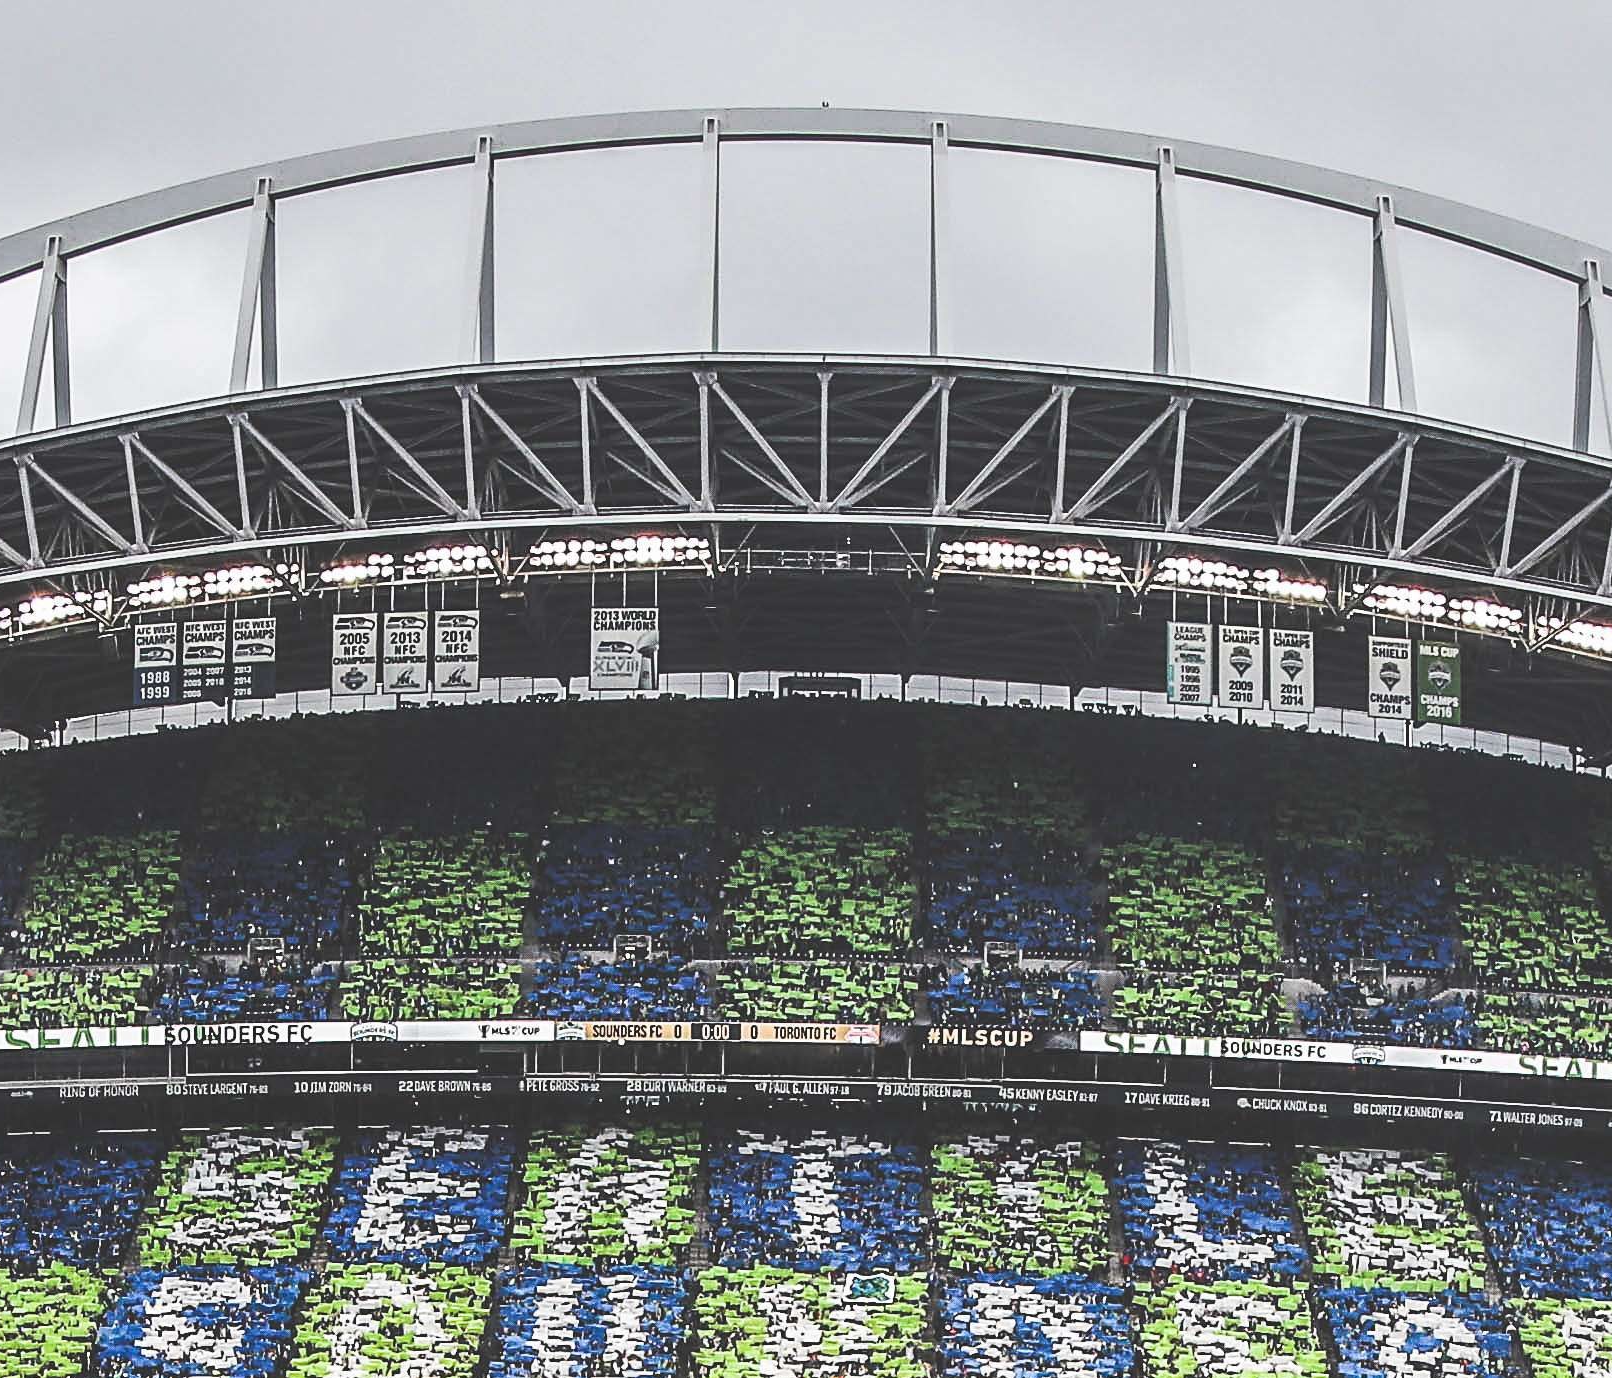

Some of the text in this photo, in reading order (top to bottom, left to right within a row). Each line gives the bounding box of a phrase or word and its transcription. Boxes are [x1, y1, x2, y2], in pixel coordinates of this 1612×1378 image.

[594, 611, 656, 620] 2013 WORLD
[154, 625, 175, 634] WEST
[203, 623, 224, 631] WEST
[253, 620, 274, 629] WEST
[594, 621, 656, 631] CHAMPIONS
[136, 635, 175, 646] CHAMPS
[185, 632, 224, 642] CHAMPS
[235, 629, 274, 640] CHAMPS
[340, 633, 369, 645] 2005
[390, 632, 420, 644] 2013
[442, 630, 472, 643] 2014
[1223, 635, 1259, 645] CHAMPS
[344, 645, 365, 655] NFC
[395, 645, 416, 655] NFC
[446, 643, 468, 653] NFC
[1274, 639, 1310, 649] CHAMPS
[1372, 647, 1408, 659] SHIELD
[1441, 647, 1459, 658] CUP
[593, 661, 638, 672] XLVIII
[140, 671, 170, 684] 1988
[1229, 681, 1253, 691] 2009
[1281, 684, 1303, 695] 2011
[140, 686, 170, 699] 1999
[1229, 692, 1253, 702] 2010
[1280, 695, 1303, 705] 2014
[1370, 693, 1411, 705] CHAMPS
[1421, 694, 1459, 707] CHAMPS
[1379, 704, 1402, 714] 2014
[1427, 705, 1452, 718] 2016
[165, 1024, 313, 1044] SOUNDERS FC
[521, 1026, 540, 1036] CUP
[593, 1025, 682, 1039] SOUNDERS FC 0
[701, 1025, 730, 1039] 0:00
[750, 1025, 837, 1039] 0 TORONTO FC
[927, 1027, 1034, 1047] #MLSCUP
[1307, 1045, 1327, 1059] FC
[59, 1084, 139, 1098] RING OF HONOR
[166, 1082, 248, 1096] 80 STEVE LARGENT
[294, 1081, 352, 1094] 10 JIM ZORN
[398, 1079, 471, 1093] 22 DAVE BROWN
[526, 1079, 580, 1092] PETE GROSS
[626, 1079, 705, 1092] 28 CURT WARNER
[802, 1082, 829, 1095] ALLEN
[876, 1084, 951, 1097] 79 JACOB GREEN
[999, 1088, 1078, 1102] 45 KENNY EASLEY
[1125, 1092, 1189, 1106] 17 DAVE KRIEG
[1252, 1098, 1307, 1112] CHUCK KNOX
[1353, 1103, 1443, 1119] 96 CORTEZ KENNEDY
[1489, 1111, 1563, 1126] 71 WALTER JONES
